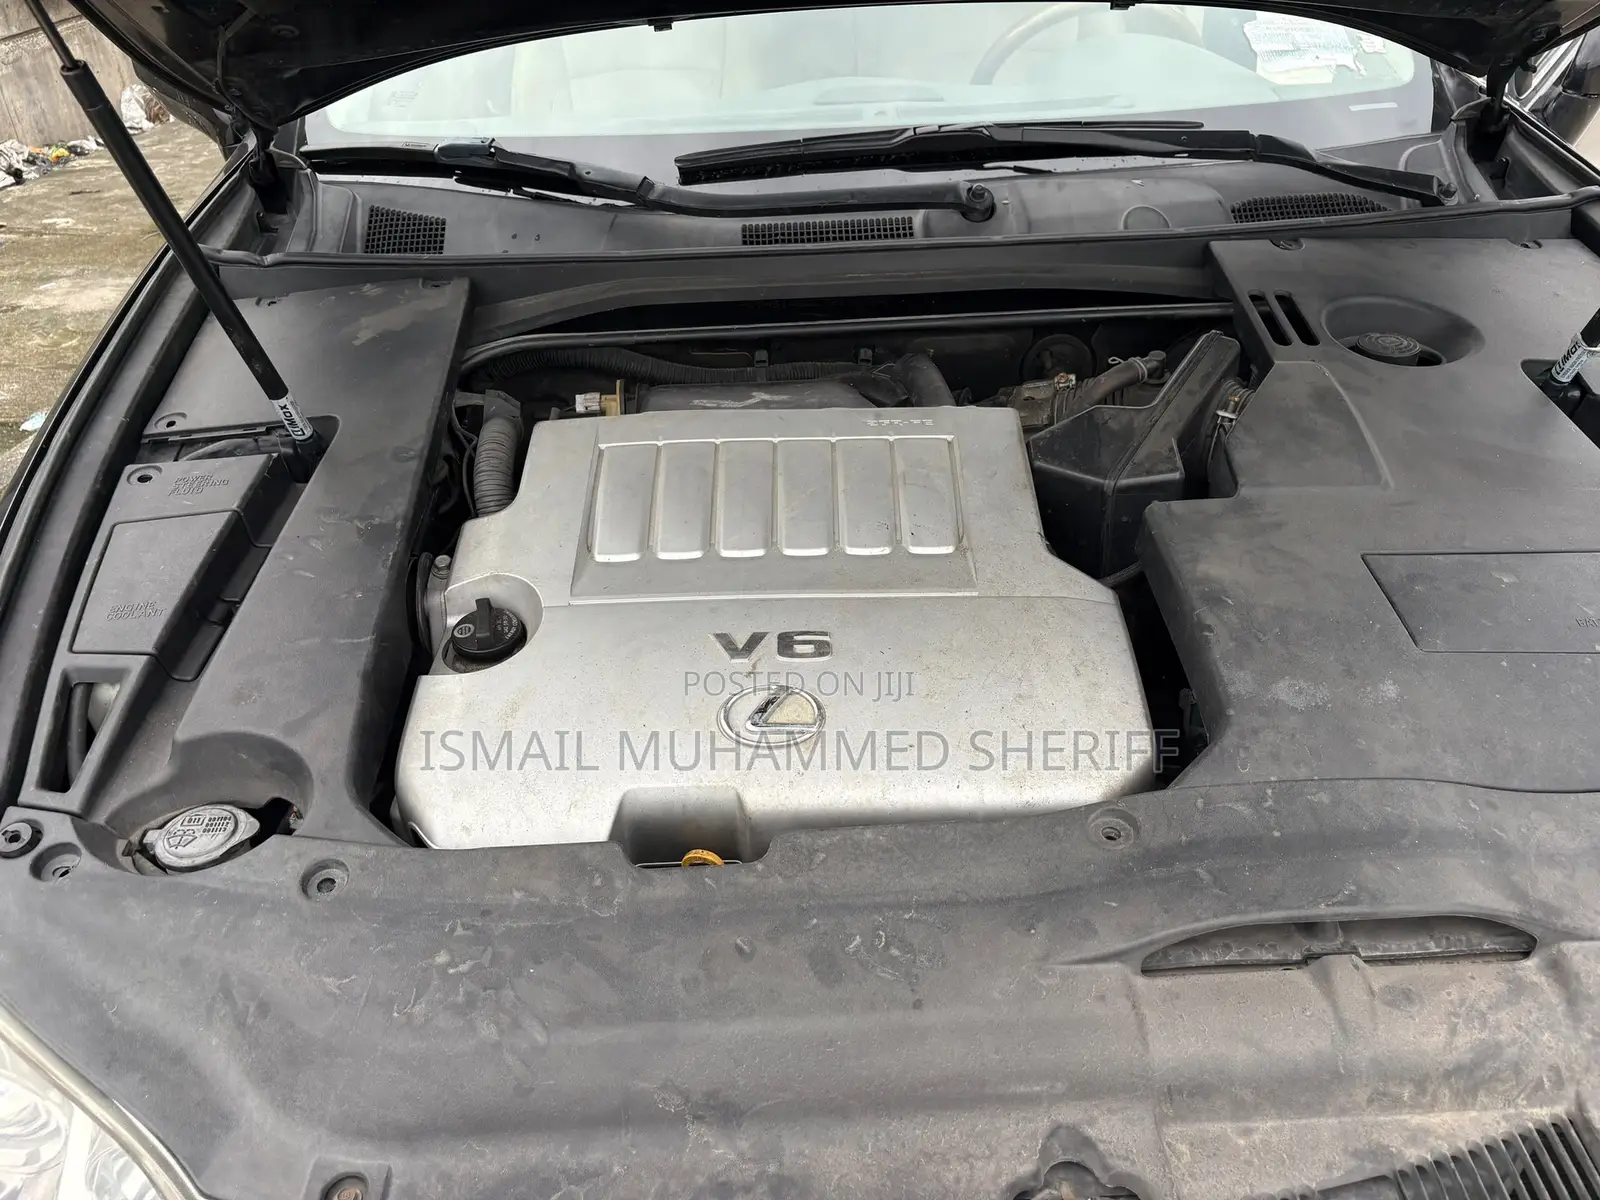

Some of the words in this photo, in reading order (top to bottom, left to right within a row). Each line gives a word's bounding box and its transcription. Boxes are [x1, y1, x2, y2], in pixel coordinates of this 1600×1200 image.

[105, 607, 168, 621] COOLANT
[109, 601, 157, 614] ENGINE
[709, 631, 833, 662] V6
